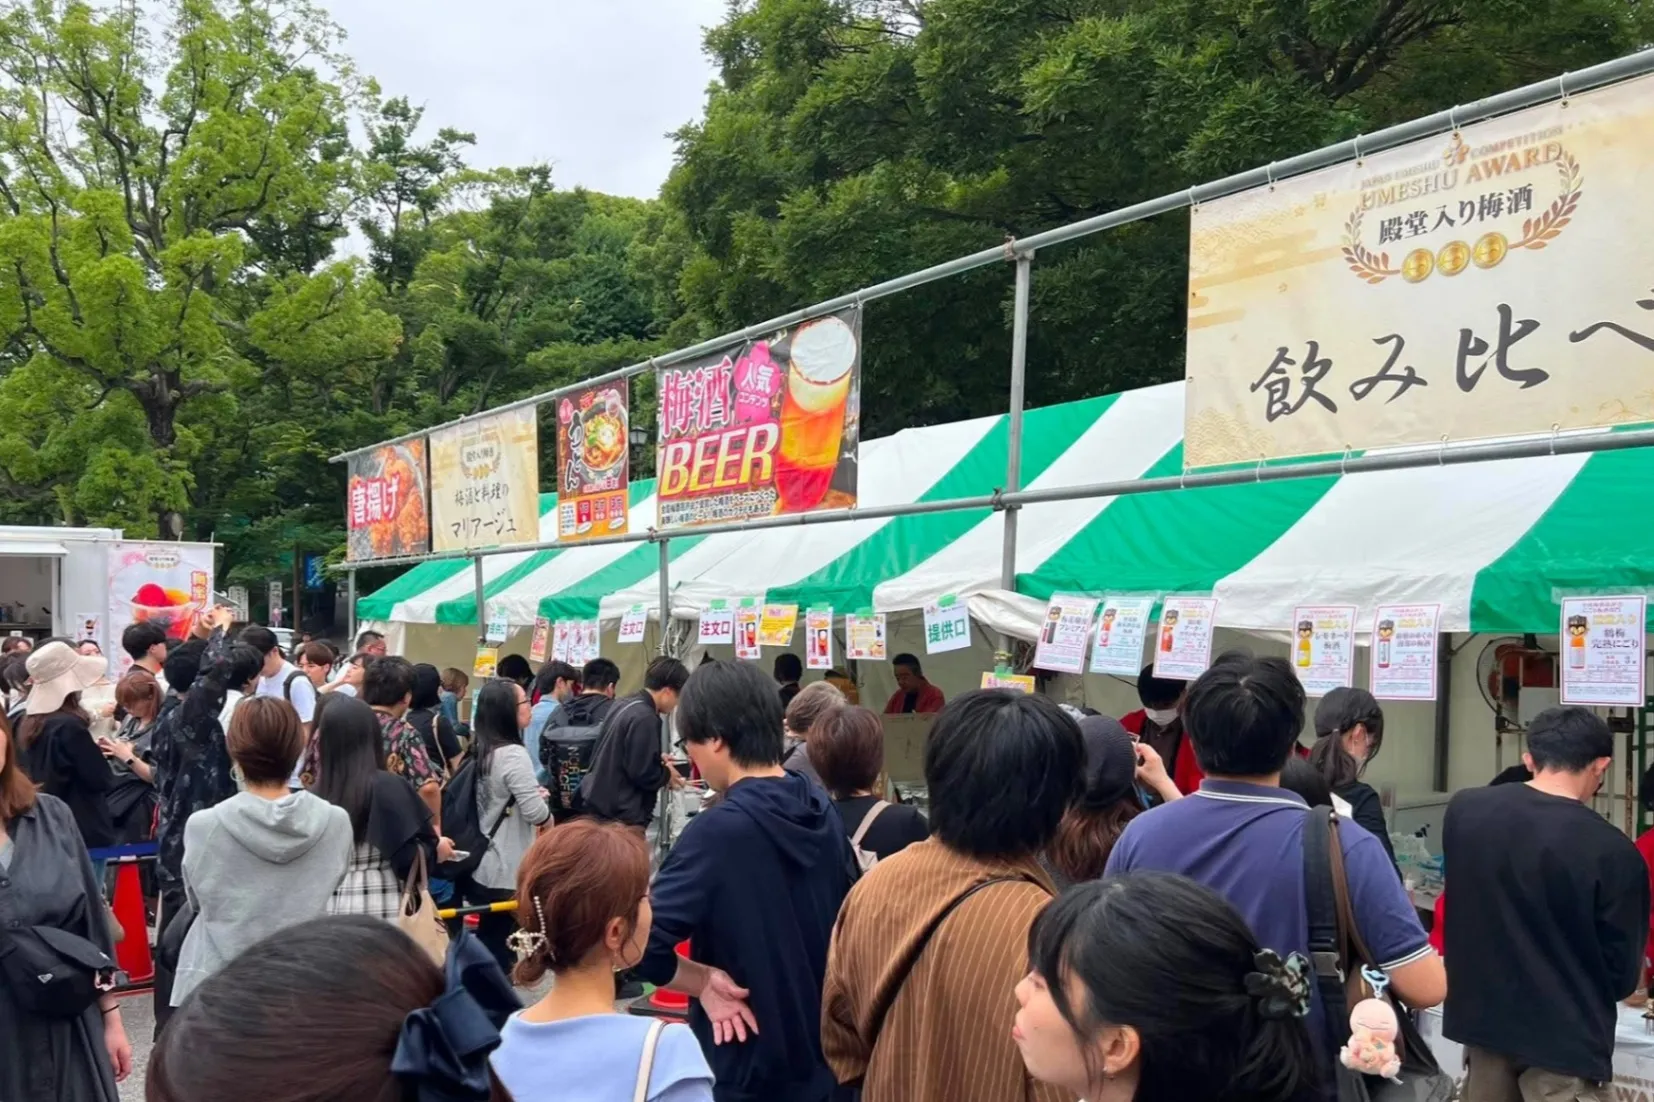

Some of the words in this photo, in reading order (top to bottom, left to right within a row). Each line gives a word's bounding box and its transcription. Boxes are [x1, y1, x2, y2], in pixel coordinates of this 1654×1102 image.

[1361, 167, 1459, 212] UMESHU
[1466, 140, 1563, 185] AWARD
[1378, 183, 1533, 246] 殿堂入り梅酒
[741, 362, 774, 394] 人気
[661, 356, 733, 440] 梅酒
[660, 421, 779, 500] BEER
[351, 474, 400, 530] 唐揚げ
[451, 508, 517, 540] マリアージュ
[620, 620, 644, 637] 注文口
[700, 620, 732, 637] 注文口
[927, 618, 967, 645] 提供口
[1592, 639, 1640, 649] 完熟にごり
